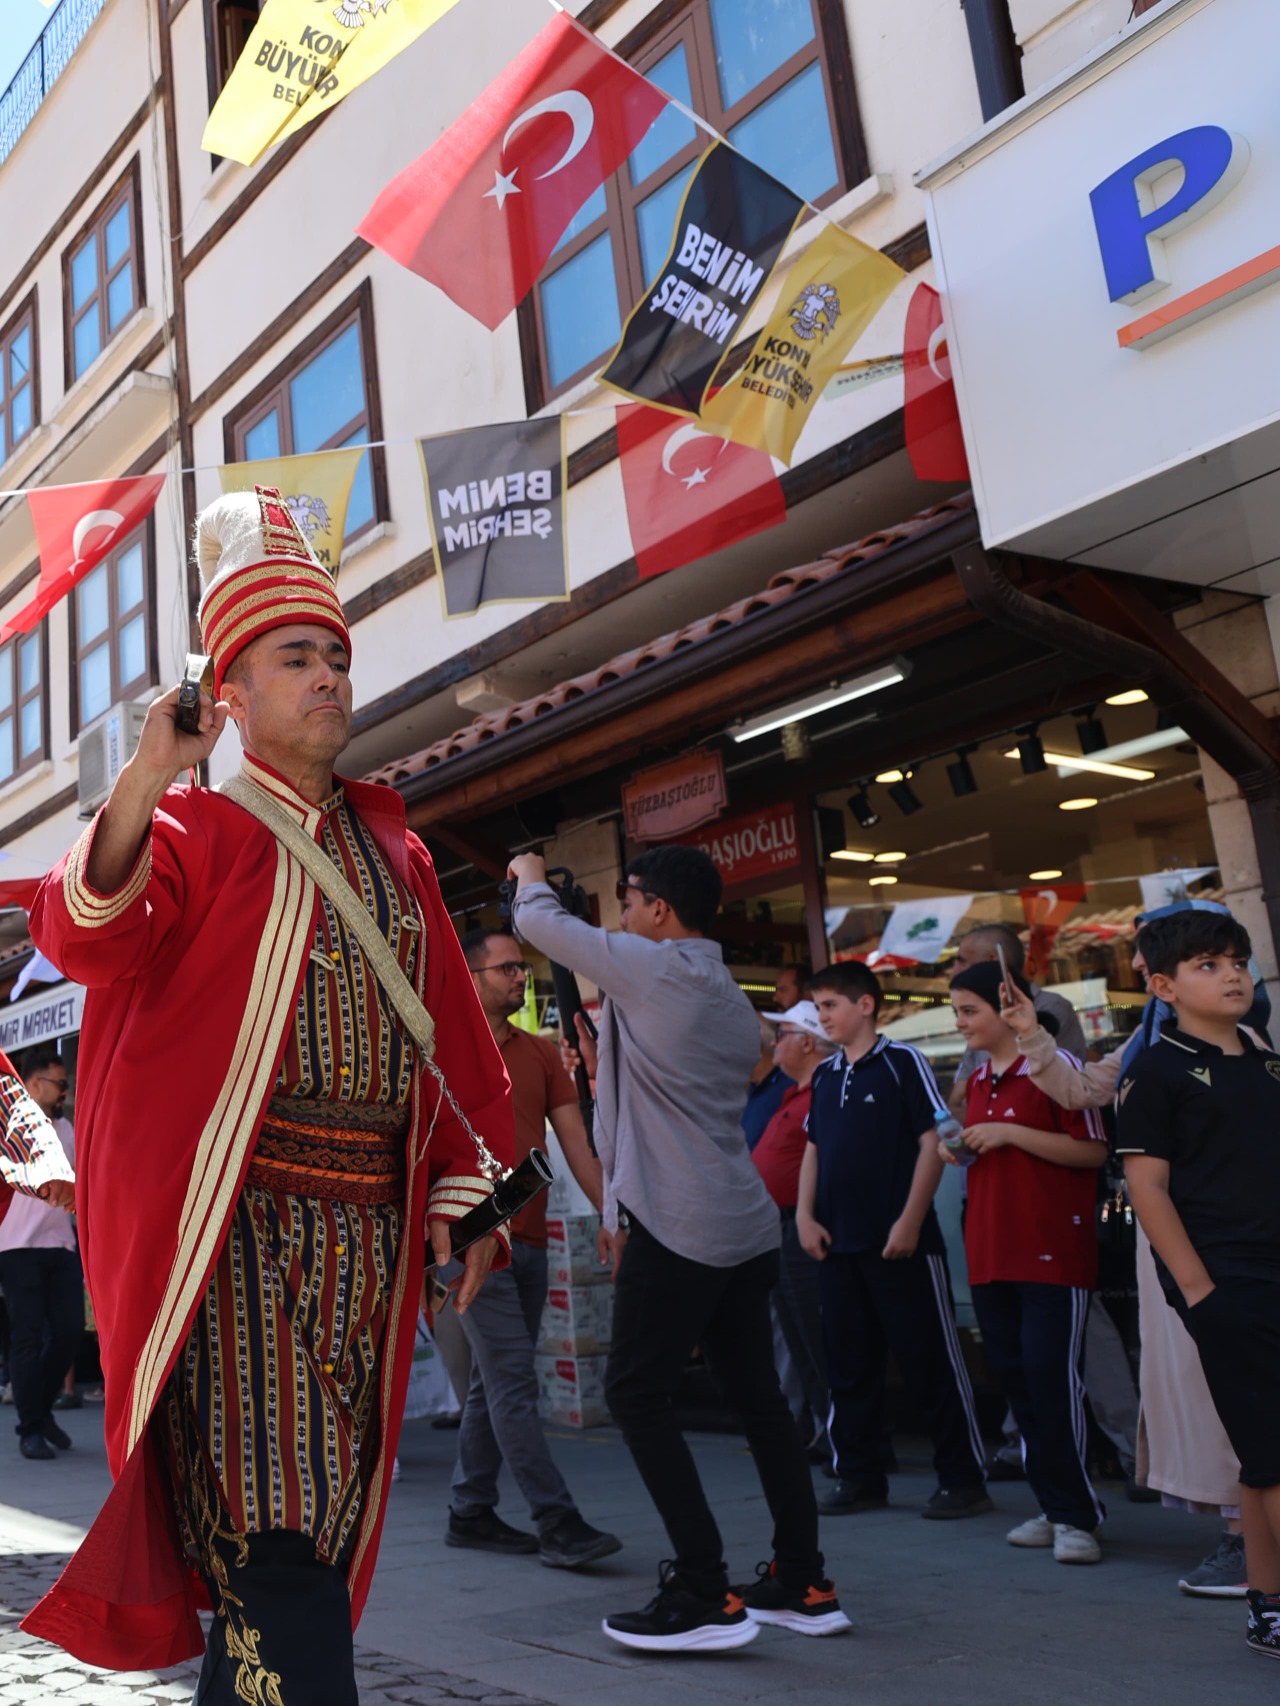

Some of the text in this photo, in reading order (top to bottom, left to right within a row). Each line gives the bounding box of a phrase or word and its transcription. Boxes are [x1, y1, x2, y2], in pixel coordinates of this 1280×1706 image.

[299, 25, 348, 60] KON
[254, 39, 339, 99] BÜYÜR
[698, 814, 796, 871] AŞIOĞLU
[770, 847, 797, 864] 1970
[22, 997, 75, 1041] MARKET
